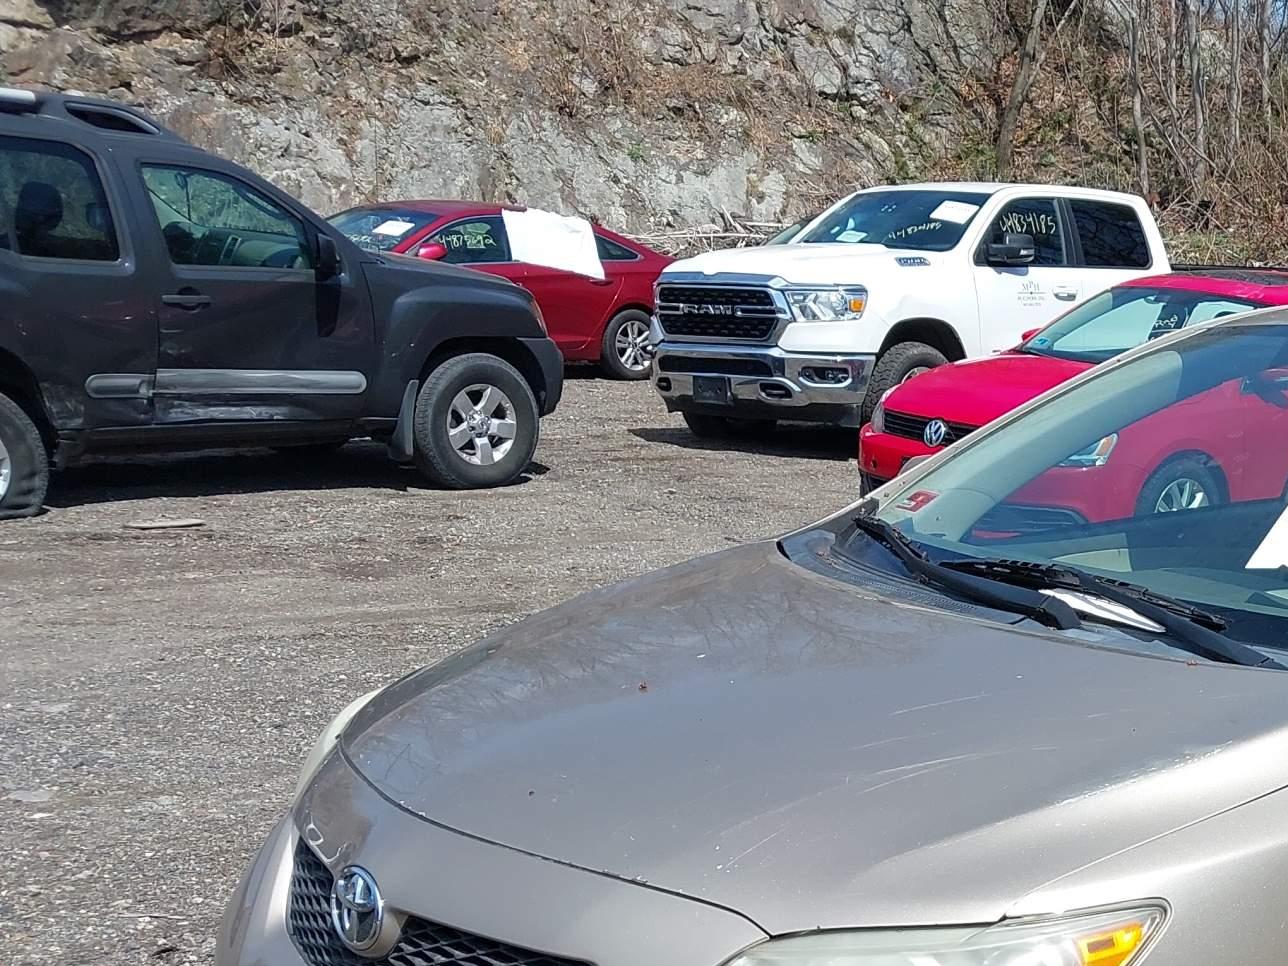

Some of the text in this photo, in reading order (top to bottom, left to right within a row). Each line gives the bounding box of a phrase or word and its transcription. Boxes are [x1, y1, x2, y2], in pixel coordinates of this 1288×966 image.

[999, 212, 1056, 234] 44834185
[682, 304, 732, 316] RAM
[924, 420, 945, 447] VW
